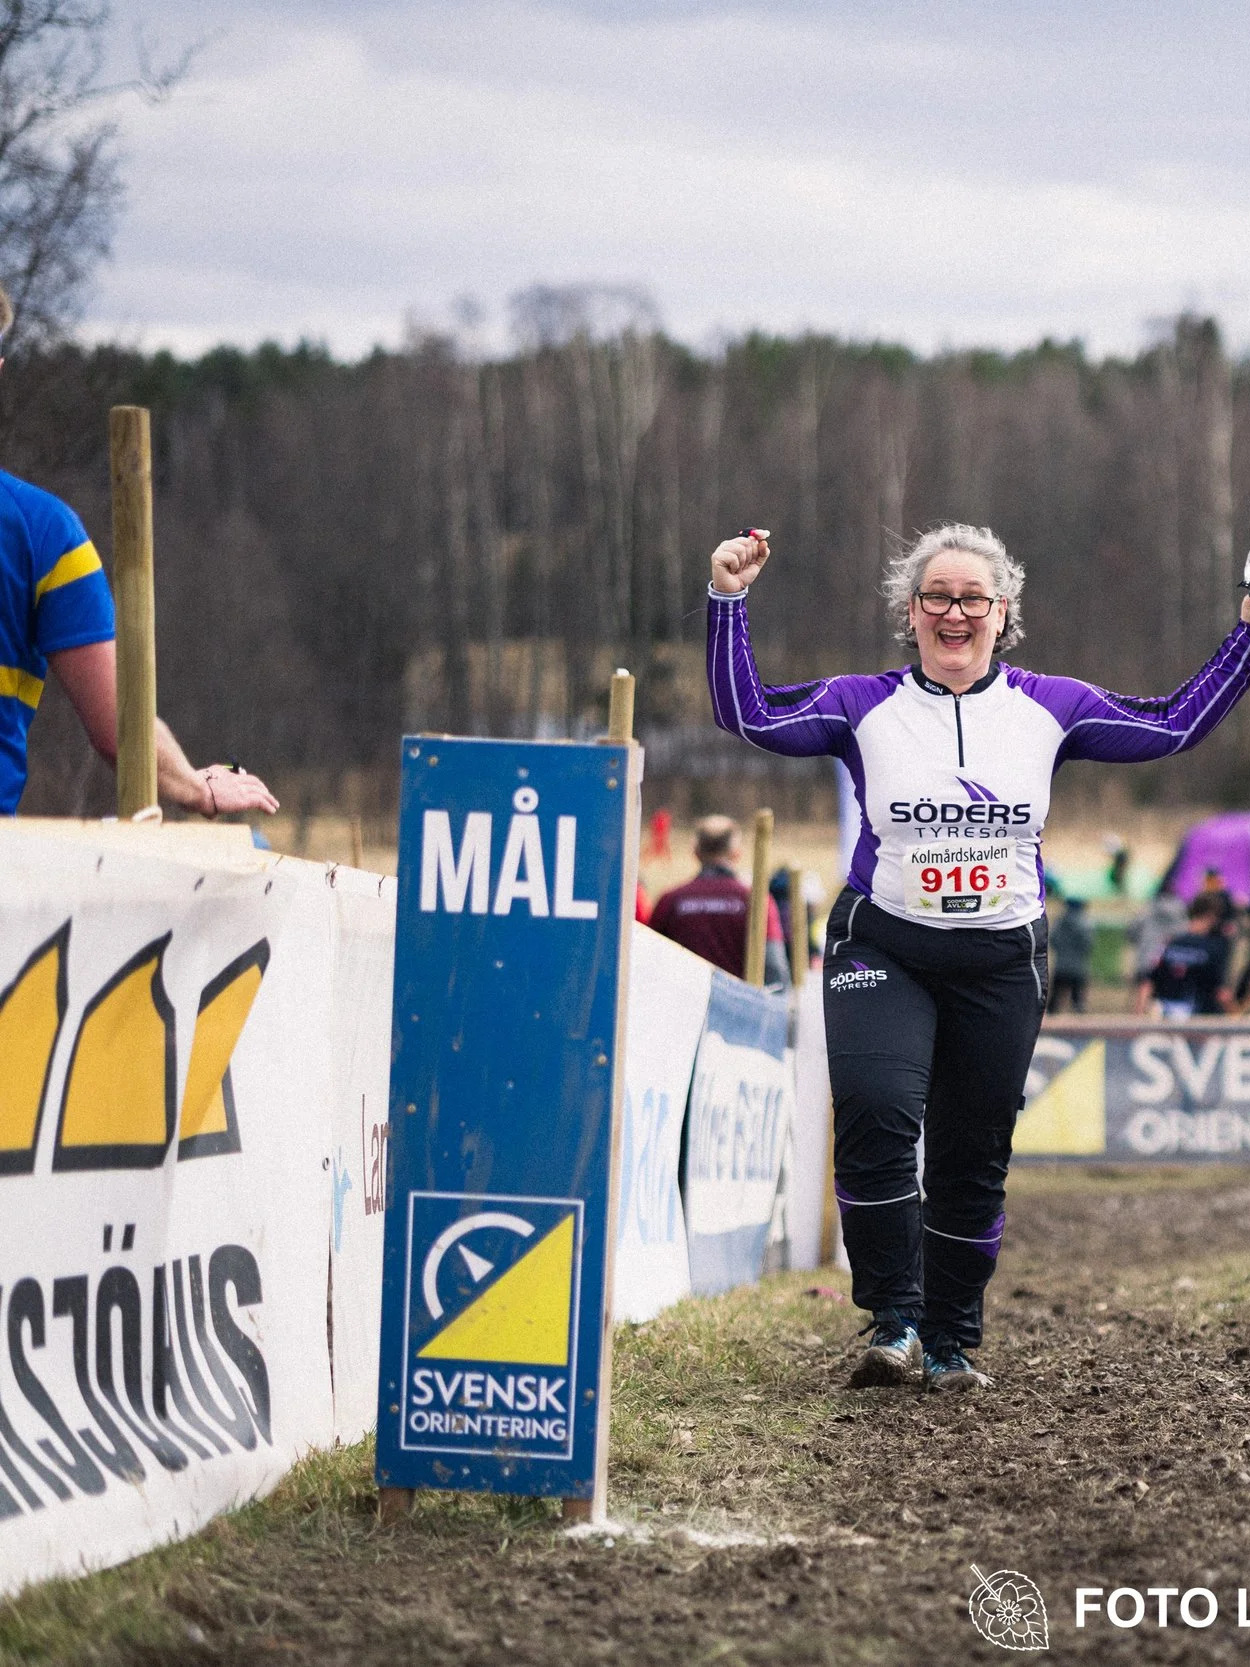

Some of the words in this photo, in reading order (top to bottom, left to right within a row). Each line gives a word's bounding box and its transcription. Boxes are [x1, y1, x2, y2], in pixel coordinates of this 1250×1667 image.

[889, 798, 1031, 825] SÖDERS
[915, 826, 1008, 839] TYRESÖ
[420, 786, 599, 919] MÅL
[911, 846, 1008, 864] Kolmårdskavlen
[921, 865, 990, 893] 916
[996, 874, 1007, 889] 3
[830, 970, 888, 989] SÖDERS
[412, 1369, 567, 1413] SVENSK
[410, 1411, 567, 1441] ORIENTERING
